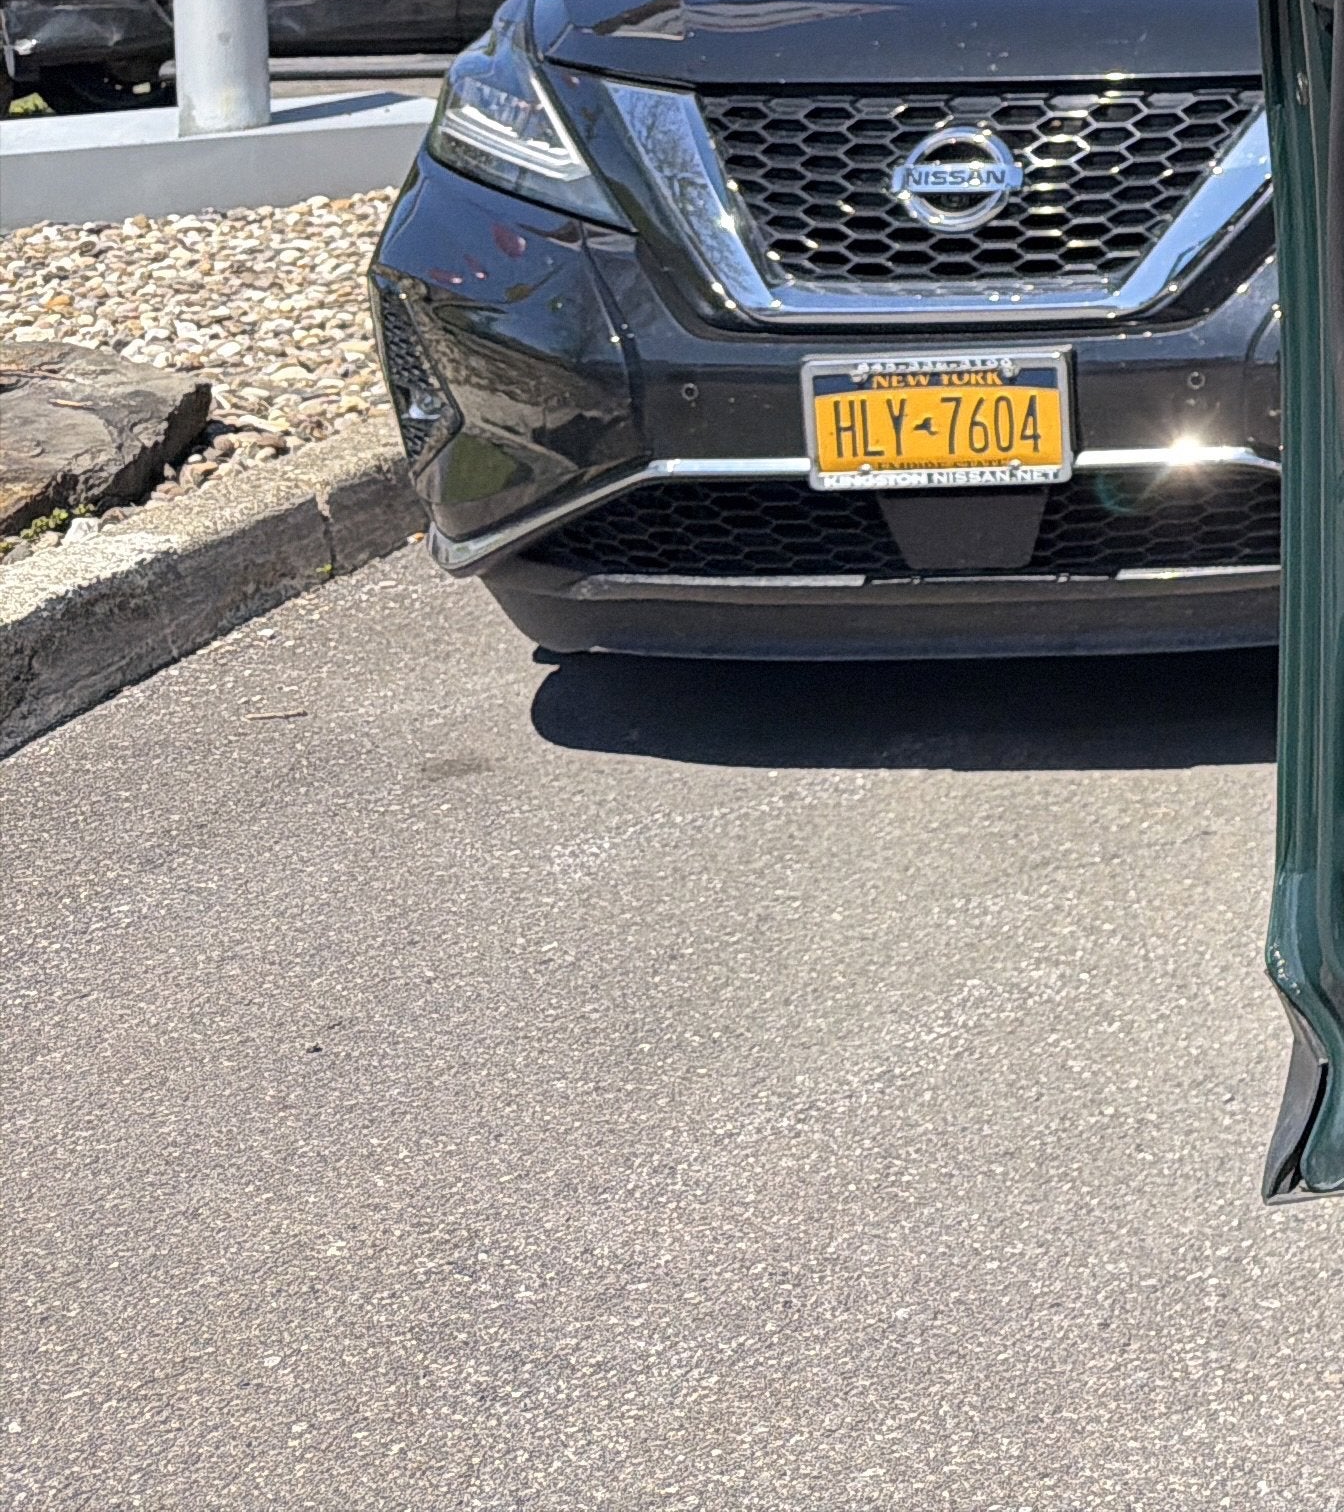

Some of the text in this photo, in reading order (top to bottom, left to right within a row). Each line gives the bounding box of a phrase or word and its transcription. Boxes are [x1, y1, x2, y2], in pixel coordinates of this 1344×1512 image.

[907, 169, 1006, 186] NISSAN
[872, 370, 1003, 388] NEW YORK
[833, 394, 1041, 458] HLY 7604
[824, 468, 1060, 488] KINGSTON NISSAN.NET
